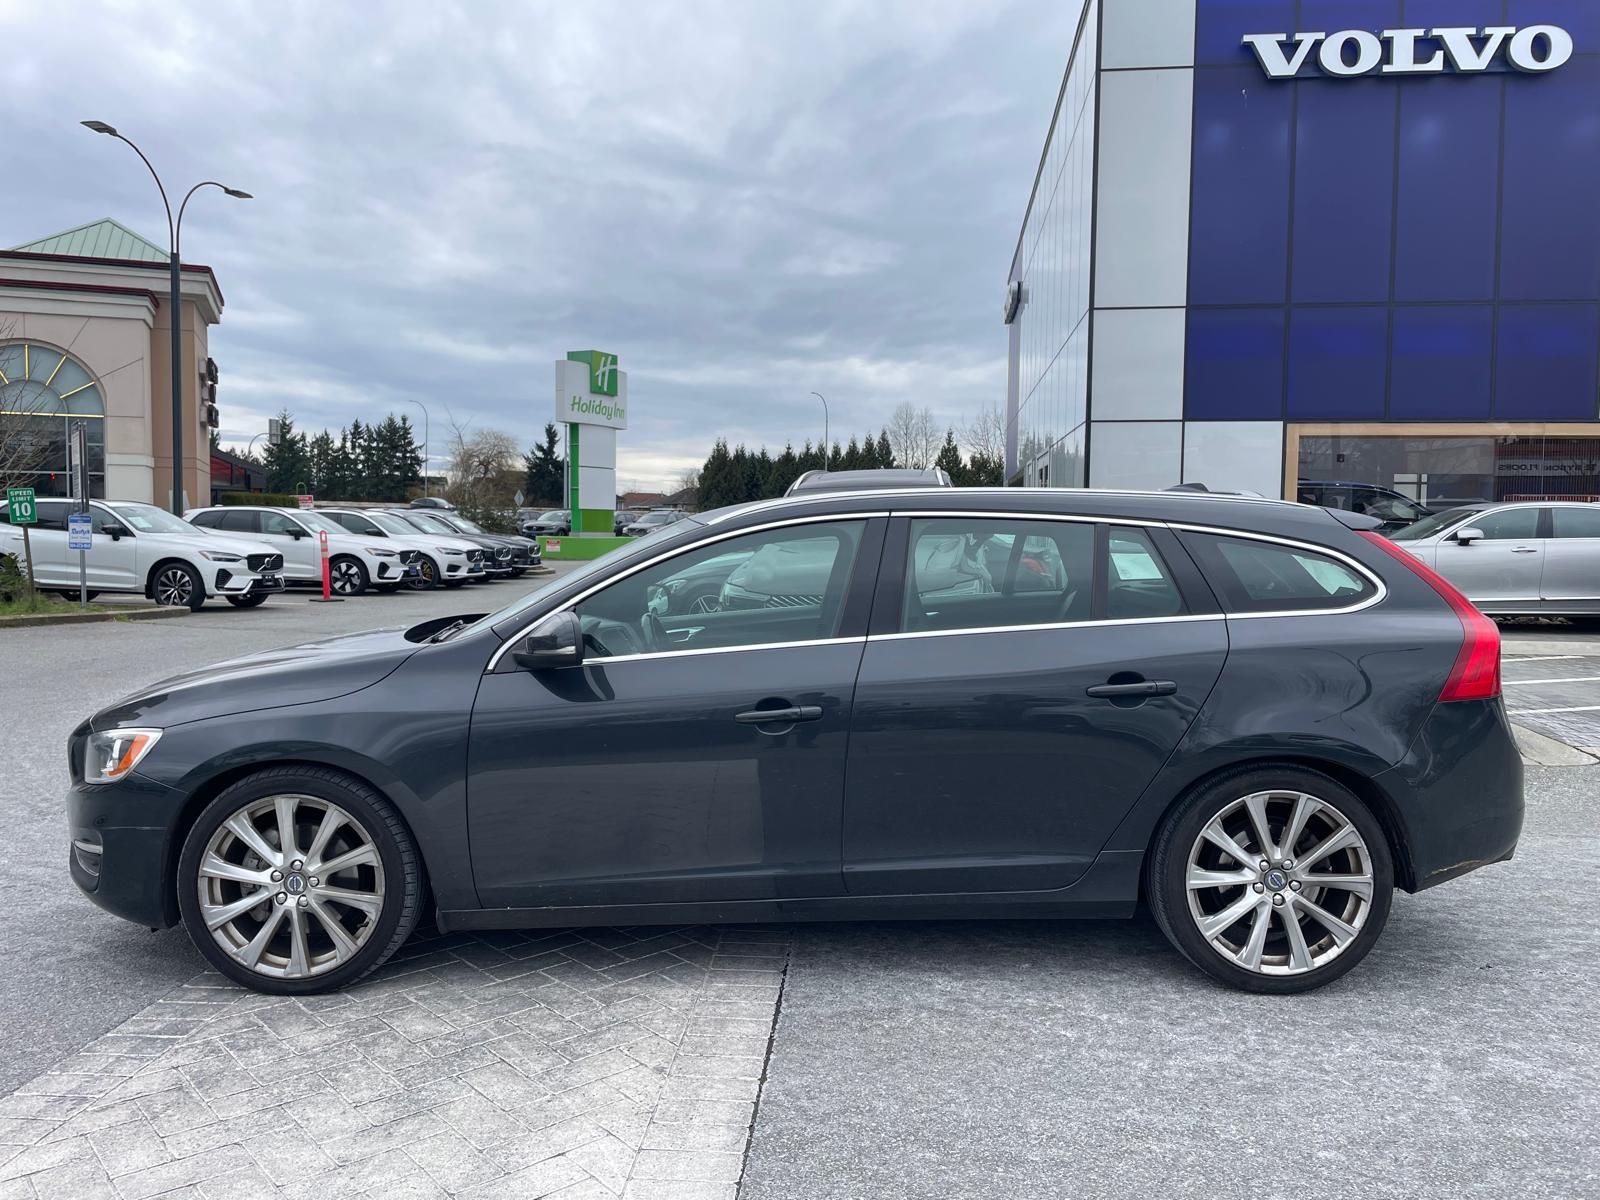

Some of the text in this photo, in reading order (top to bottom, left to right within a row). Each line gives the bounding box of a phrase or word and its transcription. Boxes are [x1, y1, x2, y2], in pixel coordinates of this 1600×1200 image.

[1241, 24, 1574, 79] VOLVO
[570, 395, 625, 420] Holiday Inn
[12, 502, 32, 517] 10
